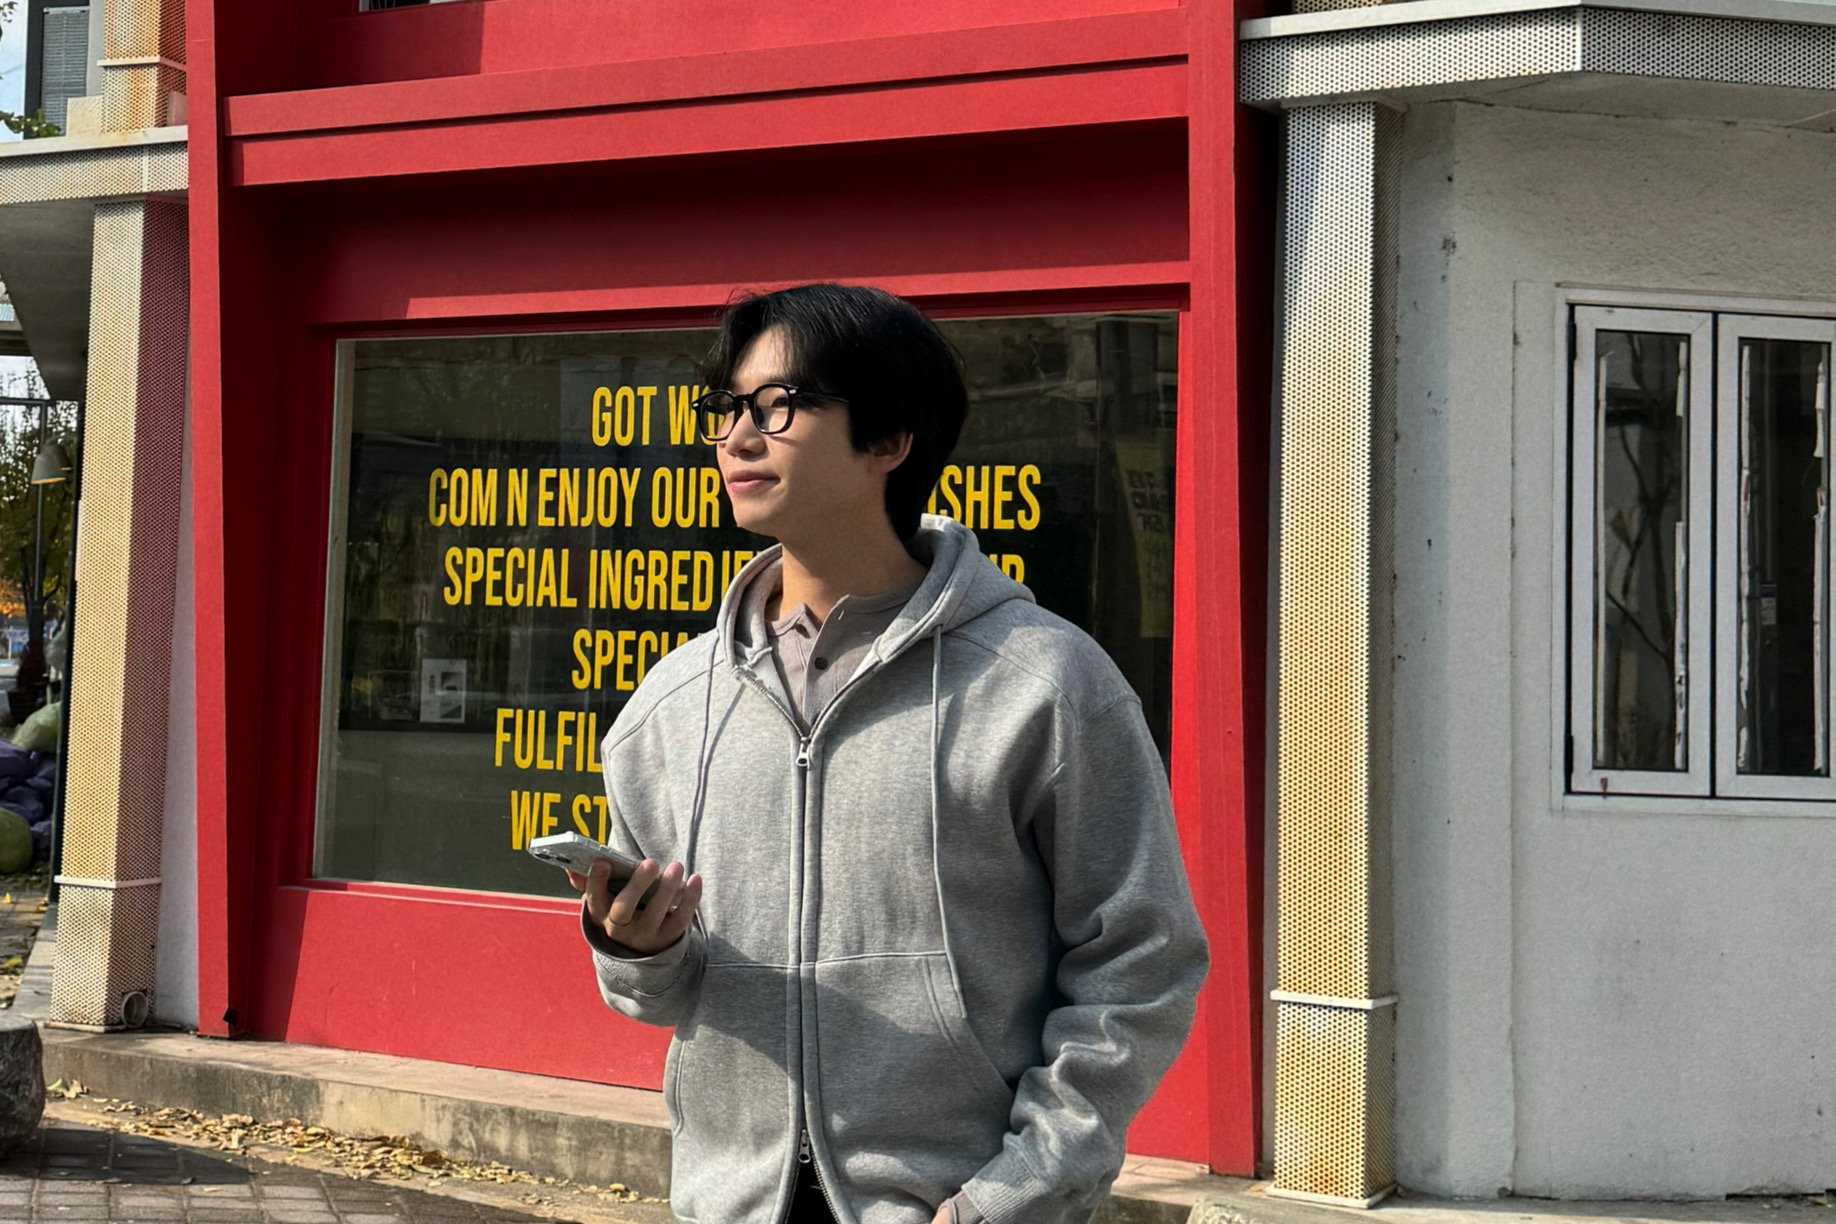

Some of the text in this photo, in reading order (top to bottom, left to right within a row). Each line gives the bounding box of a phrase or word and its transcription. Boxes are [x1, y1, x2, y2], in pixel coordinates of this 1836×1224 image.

[592, 386, 657, 447] GOT
[428, 468, 498, 527] COM
[506, 468, 528, 526] N
[537, 467, 641, 527] ENJOY
[651, 467, 720, 528] OUR
[443, 547, 577, 607] SPECIAL
[571, 628, 704, 690] SPEC
